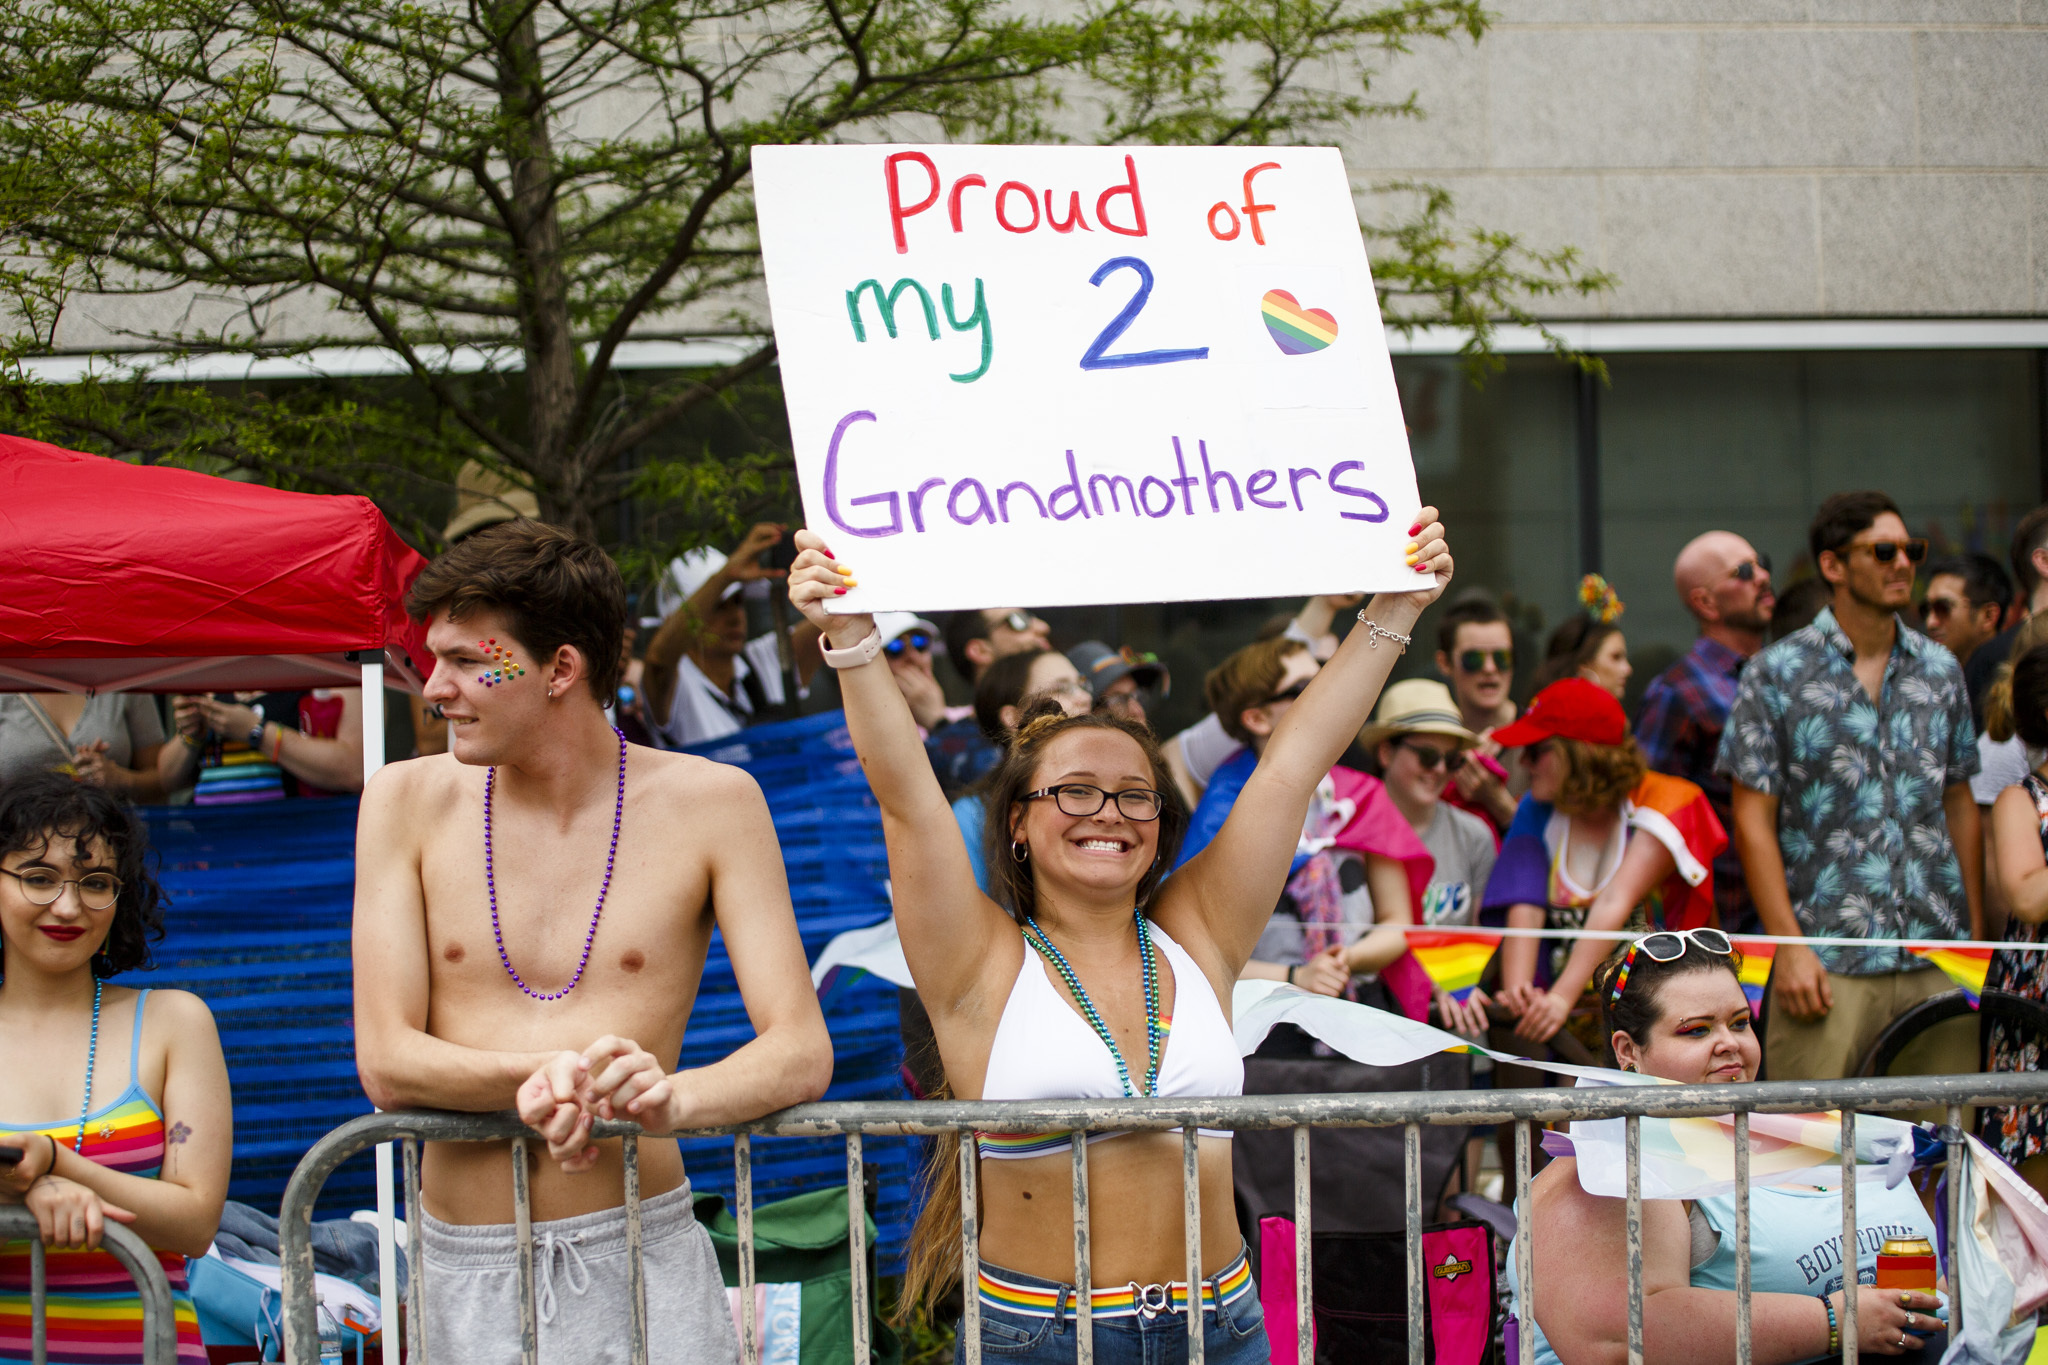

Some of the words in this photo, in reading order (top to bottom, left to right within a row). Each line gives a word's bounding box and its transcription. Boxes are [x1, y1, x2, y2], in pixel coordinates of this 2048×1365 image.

[884, 151, 1148, 254] Proud
[1208, 162, 1281, 245] of
[846, 278, 993, 383] my
[1080, 256, 1209, 370] 2
[822, 410, 1389, 538] Grandmothers
[1796, 1225, 1914, 1285] BOYTO
